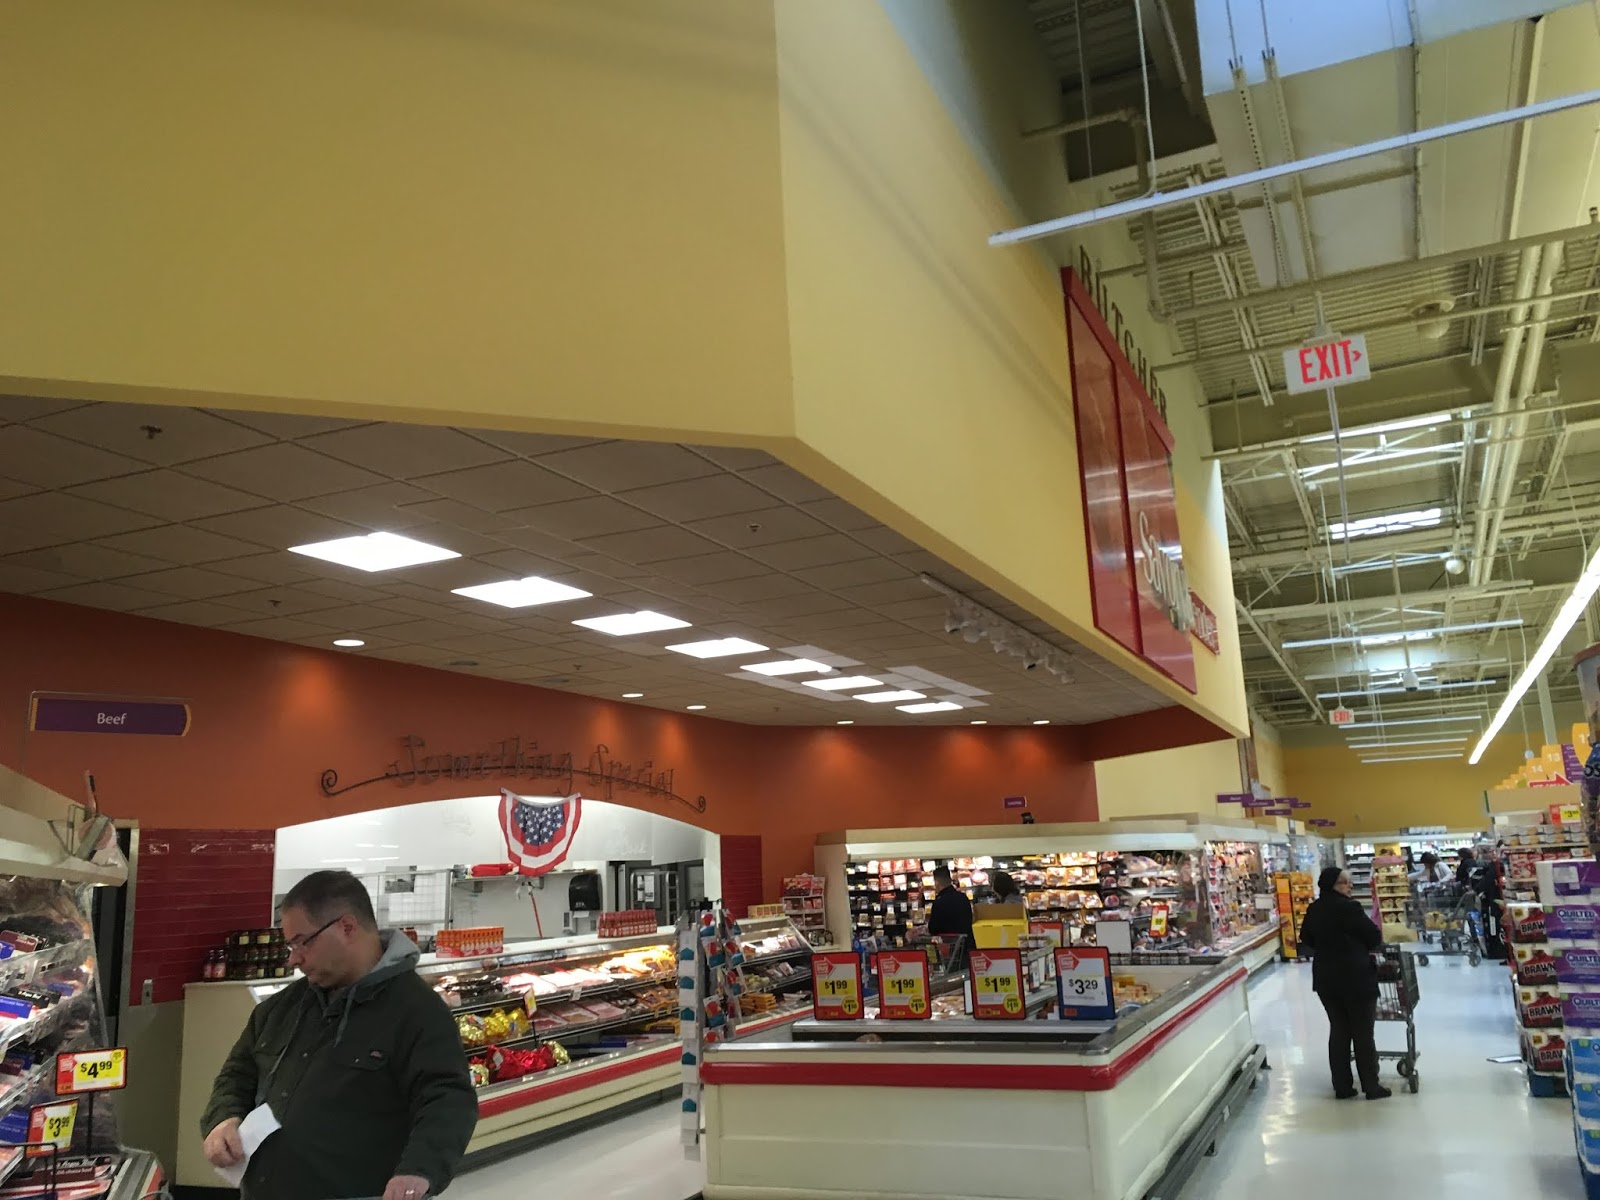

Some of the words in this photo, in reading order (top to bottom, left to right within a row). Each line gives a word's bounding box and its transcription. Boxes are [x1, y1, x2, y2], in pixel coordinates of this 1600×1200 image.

[1299, 340, 1352, 384] EXIT
[97, 712, 127, 725] Beef
[1558, 909, 1596, 918] QUILTED
